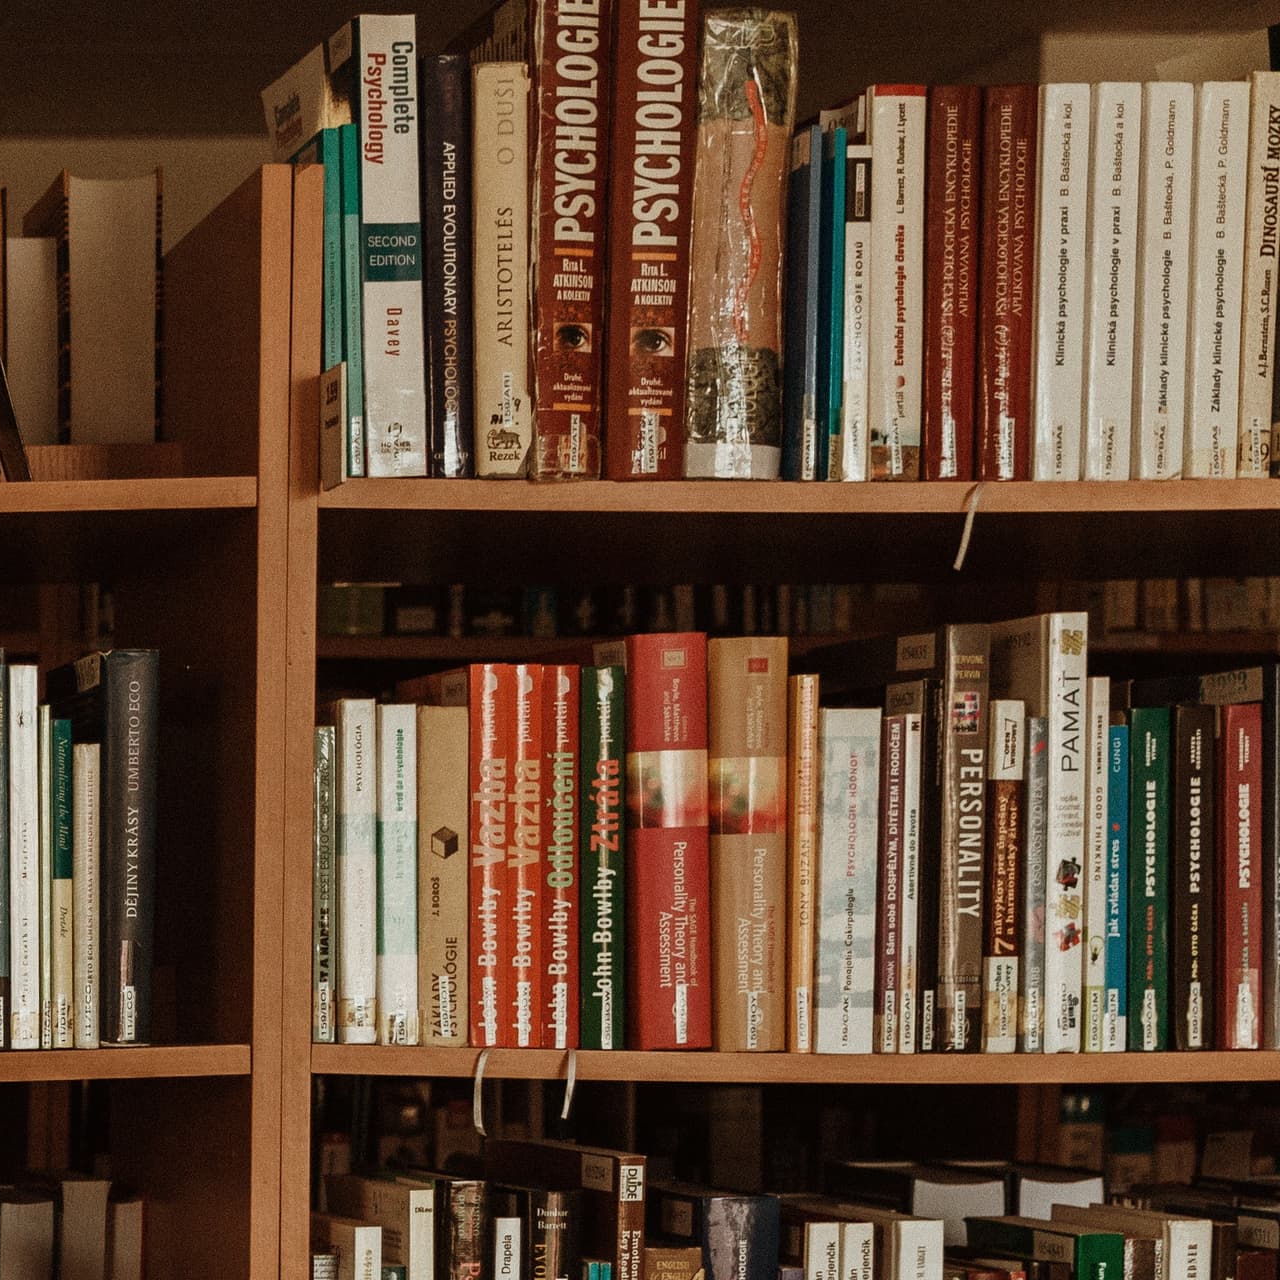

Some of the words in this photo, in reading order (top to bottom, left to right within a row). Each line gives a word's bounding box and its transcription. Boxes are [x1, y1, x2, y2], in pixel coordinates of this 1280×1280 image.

[365, 53, 385, 165] Psychology
[390, 41, 410, 135] Complete
[367, 235, 417, 248] SECOND
[1059, 206, 1069, 231] praxi
[369, 254, 416, 266] EDITION
[1057, 248, 1070, 317] psychologie
[387, 308, 402, 357] Davey
[1055, 321, 1066, 366] Klinická
[128, 682, 140, 714] ECO
[128, 718, 139, 792] UMBERTO
[126, 807, 138, 858] KRÁSY
[546, 752, 574, 888] Odloučení
[590, 759, 620, 853] Ztráta
[958, 748, 983, 919] PERSONALITY
[1145, 779, 1156, 897] PSYCHOLOGIE
[593, 866, 616, 943] Bowlby
